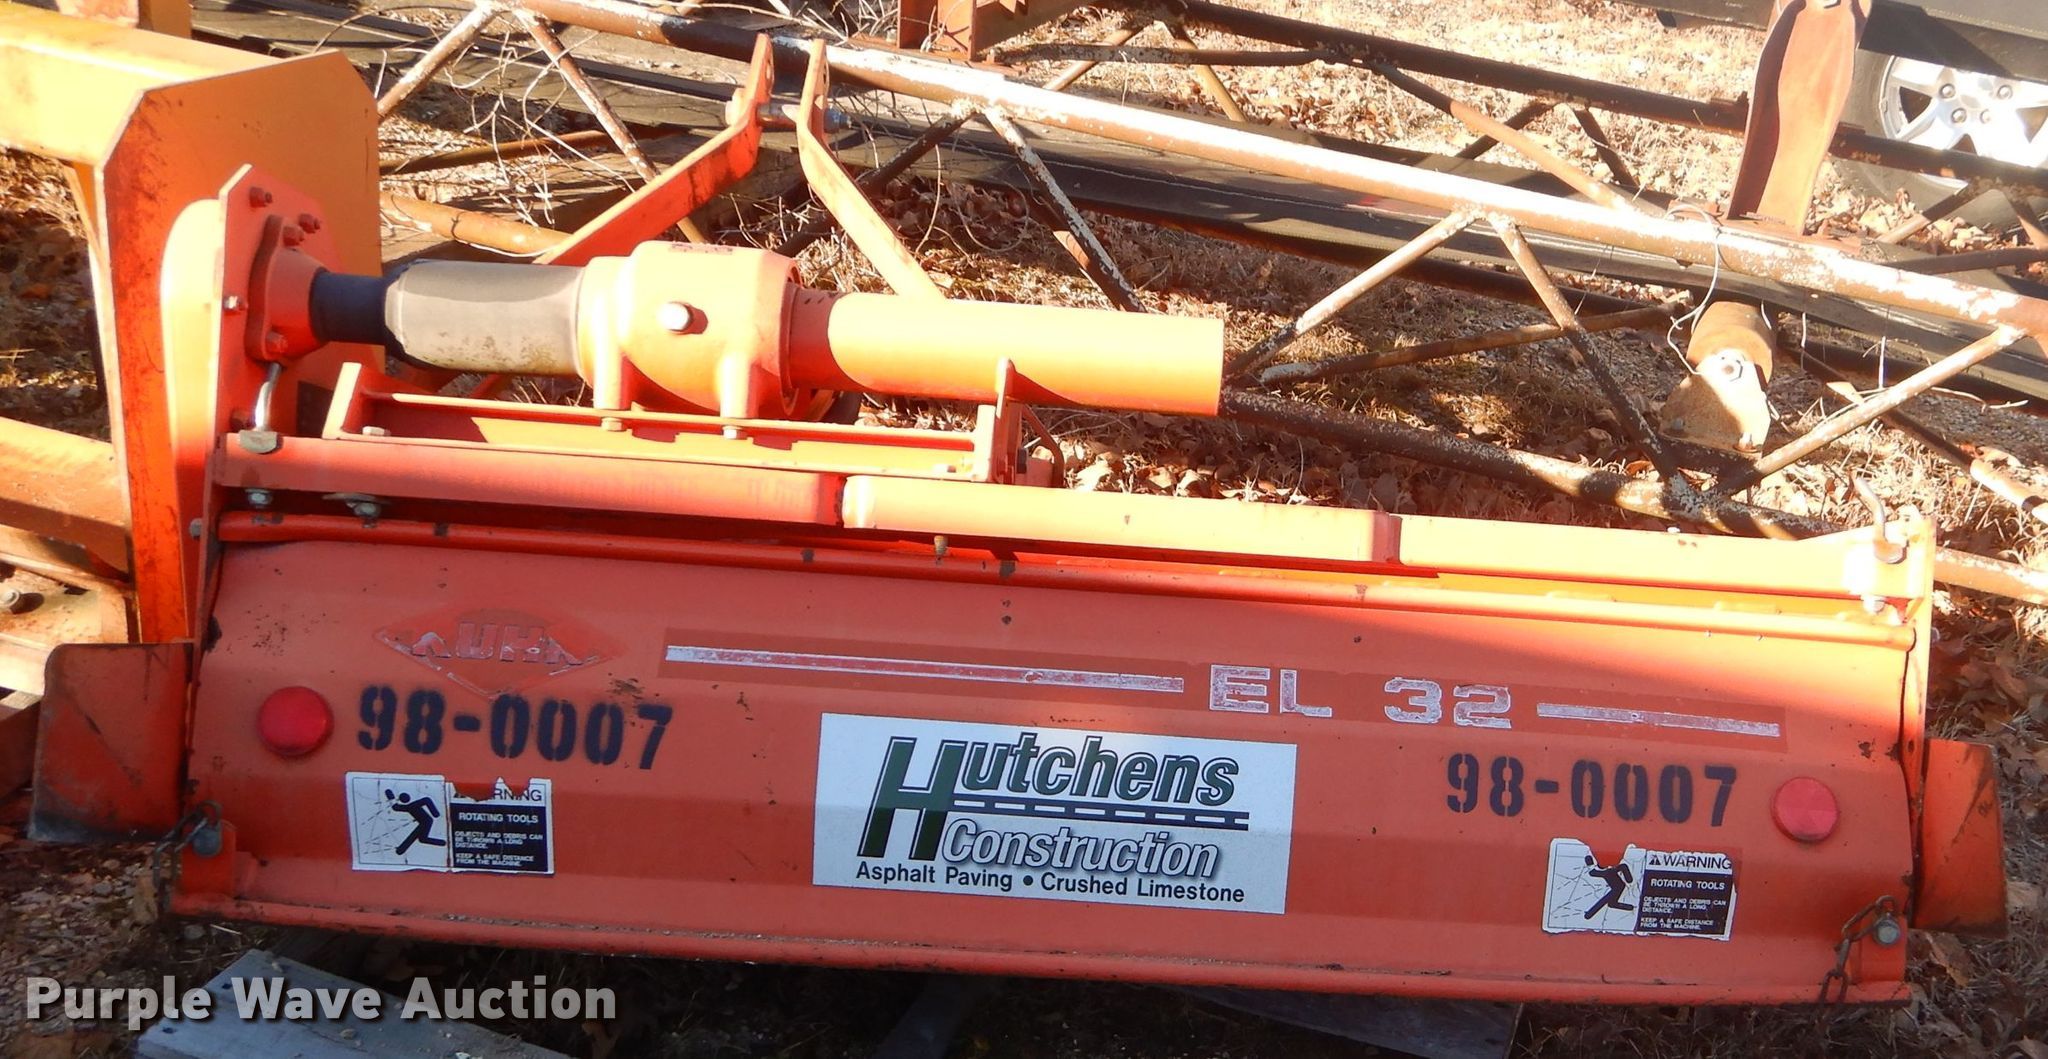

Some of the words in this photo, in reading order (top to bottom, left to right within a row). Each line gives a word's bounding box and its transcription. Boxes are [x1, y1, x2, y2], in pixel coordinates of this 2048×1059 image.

[1209, 664, 1333, 718] EL
[1384, 676, 1512, 729] 32
[357, 685, 674, 770] 98-0007
[458, 812, 503, 822] ROTATING
[507, 814, 538, 823] TOOLS
[857, 732, 1240, 860] Hutchens
[1447, 753, 1737, 827] 98-0007
[941, 818, 1221, 878] Construction
[1663, 854, 1732, 870] WARNING
[856, 861, 936, 884] Asphalt
[945, 866, 1013, 892] Paving
[1041, 872, 1127, 895] Crushed
[1137, 878, 1245, 902] Limestone
[1650, 878, 1692, 888] ROTATING
[1696, 881, 1725, 890] TOOLS
